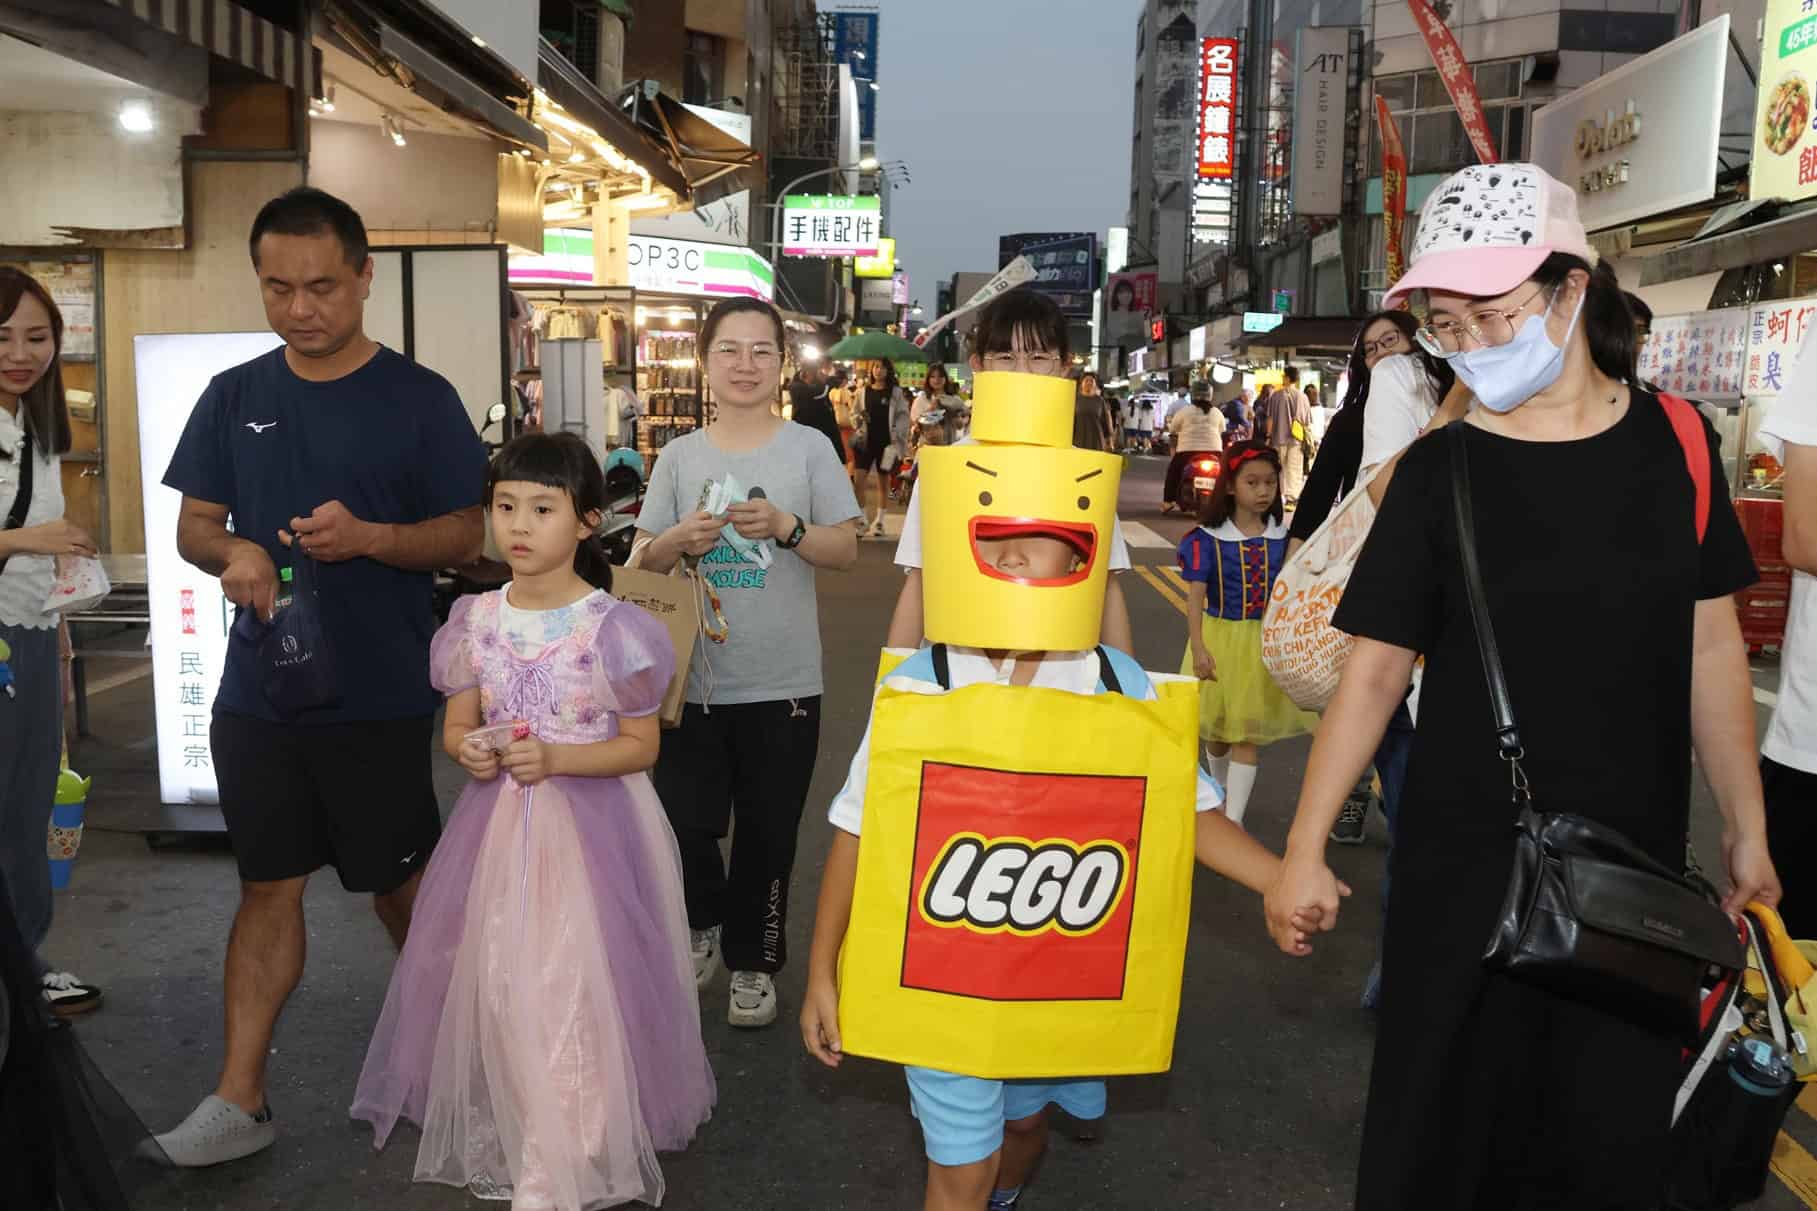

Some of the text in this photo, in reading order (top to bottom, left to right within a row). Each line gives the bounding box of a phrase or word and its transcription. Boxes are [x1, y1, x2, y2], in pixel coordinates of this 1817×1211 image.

[1304, 53, 1344, 73] AT
[1315, 119, 1328, 170] DESIGN
[789, 215, 873, 242] 手機配件
[178, 651, 209, 768] 民雄正宗
[926, 840, 1122, 929] LEGO
